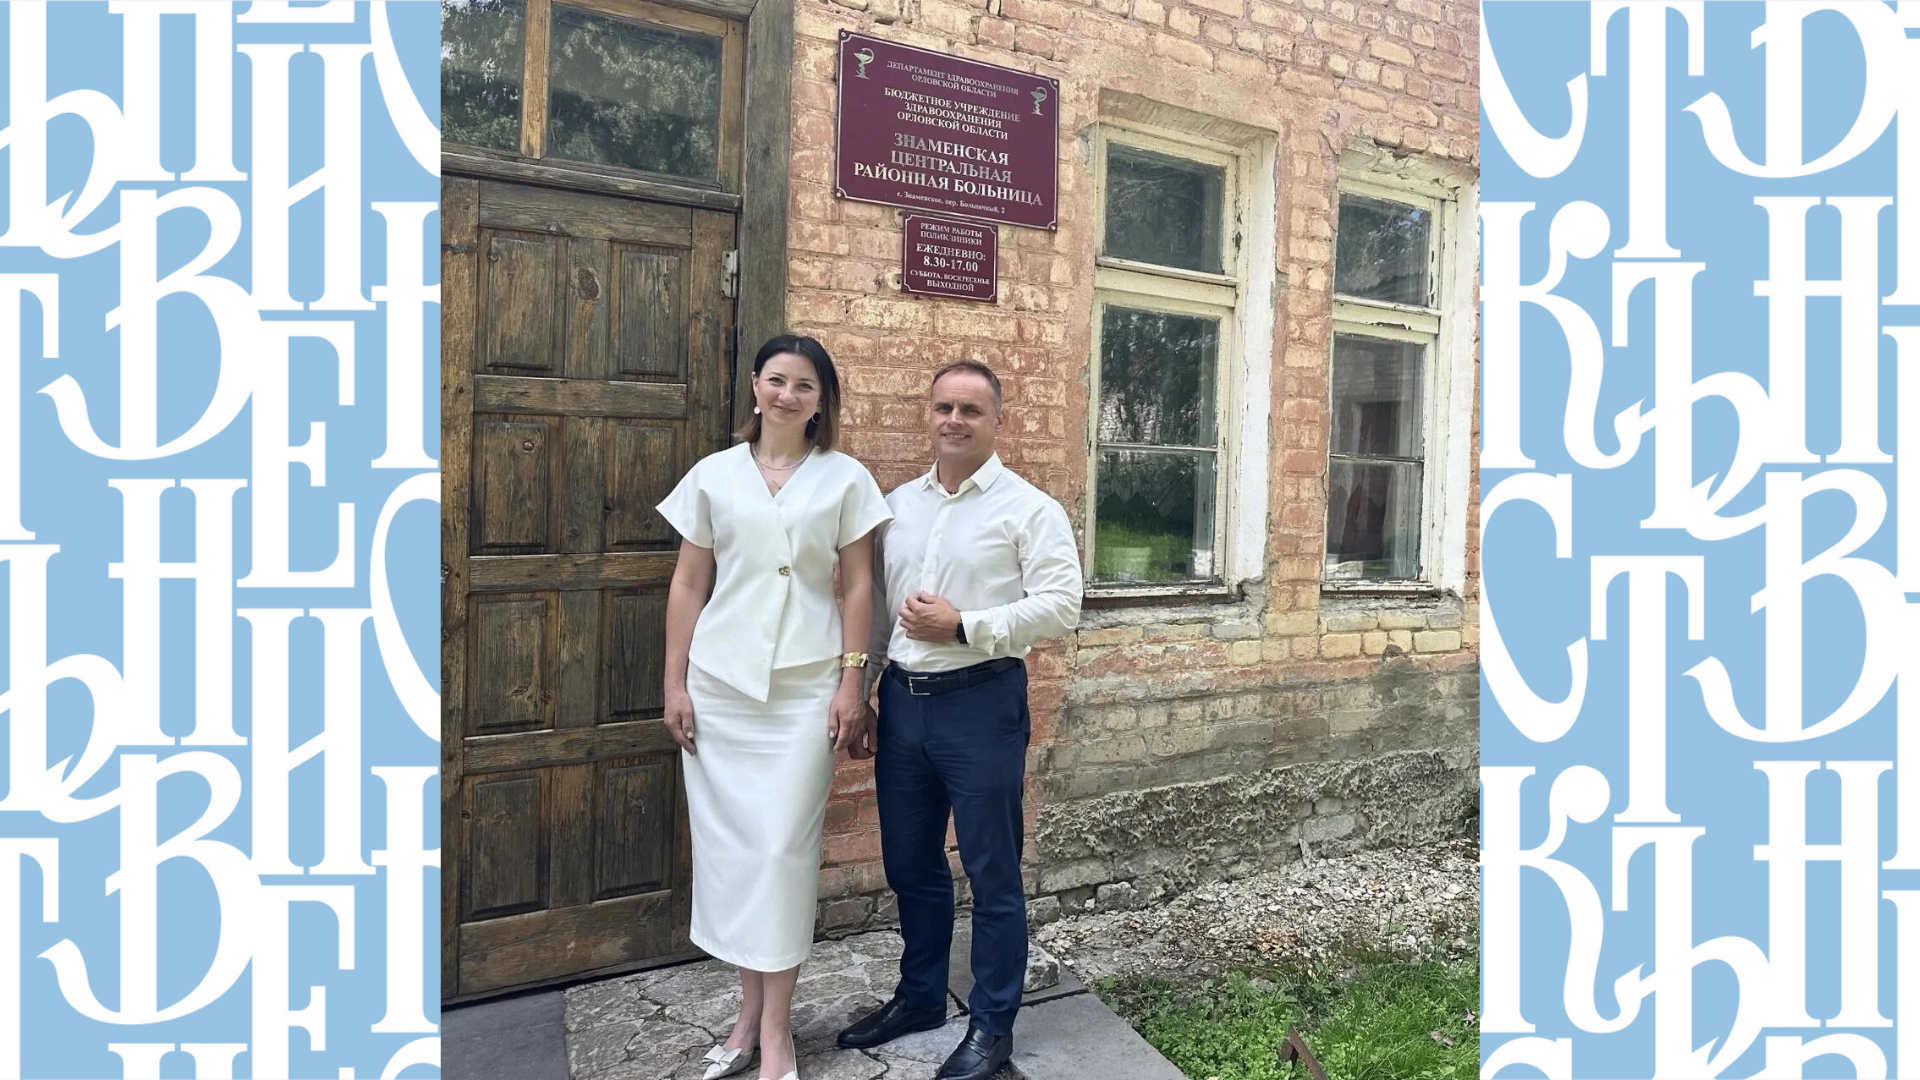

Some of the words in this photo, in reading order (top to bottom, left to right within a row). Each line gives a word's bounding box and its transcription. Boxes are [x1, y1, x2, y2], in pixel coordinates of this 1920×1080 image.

[887, 60, 945, 79] ДЕПАРТАМЕНТ
[947, 73, 1019, 95] ЗДРАВООХРАНЕНИЯ
[911, 74, 959, 90] ОРЛОВСКОЙ
[960, 84, 997, 98] ОБЛАСТИ
[884, 87, 952, 108] БЮДЖЕТНОЕ
[954, 100, 1021, 122] УЧРЕЖДЕНИЕ
[904, 102, 1002, 128] ЗДРАВООХРАНЕНИЯ
[897, 111, 960, 131] ОРЛОВСКОЙ
[962, 124, 1008, 140] ОБЛАСТИ
[893, 132, 1009, 166] ЗНАМЕНСКАЯ
[891, 150, 1012, 184] ЦЕНТРАЛЬНАЯ
[853, 162, 949, 190] РАЙОННАЯ
[954, 179, 1043, 207] БОЛЬНИЦА
[1001, 206, 1006, 214] 2
[920, 222, 950, 232] РЕЖИМ
[952, 228, 982, 238] РАБОТЫ
[920, 231, 982, 246] ПОЛИКЛИНИКИ
[916, 243, 986, 261] ЕЖЕДНЕВНО:
[923, 255, 978, 272] 8.30-17.00
[927, 279, 974, 291] ВЫХОДНОЙ
[944, 274, 990, 285] ВОСКРЕСЕНЬЕ
